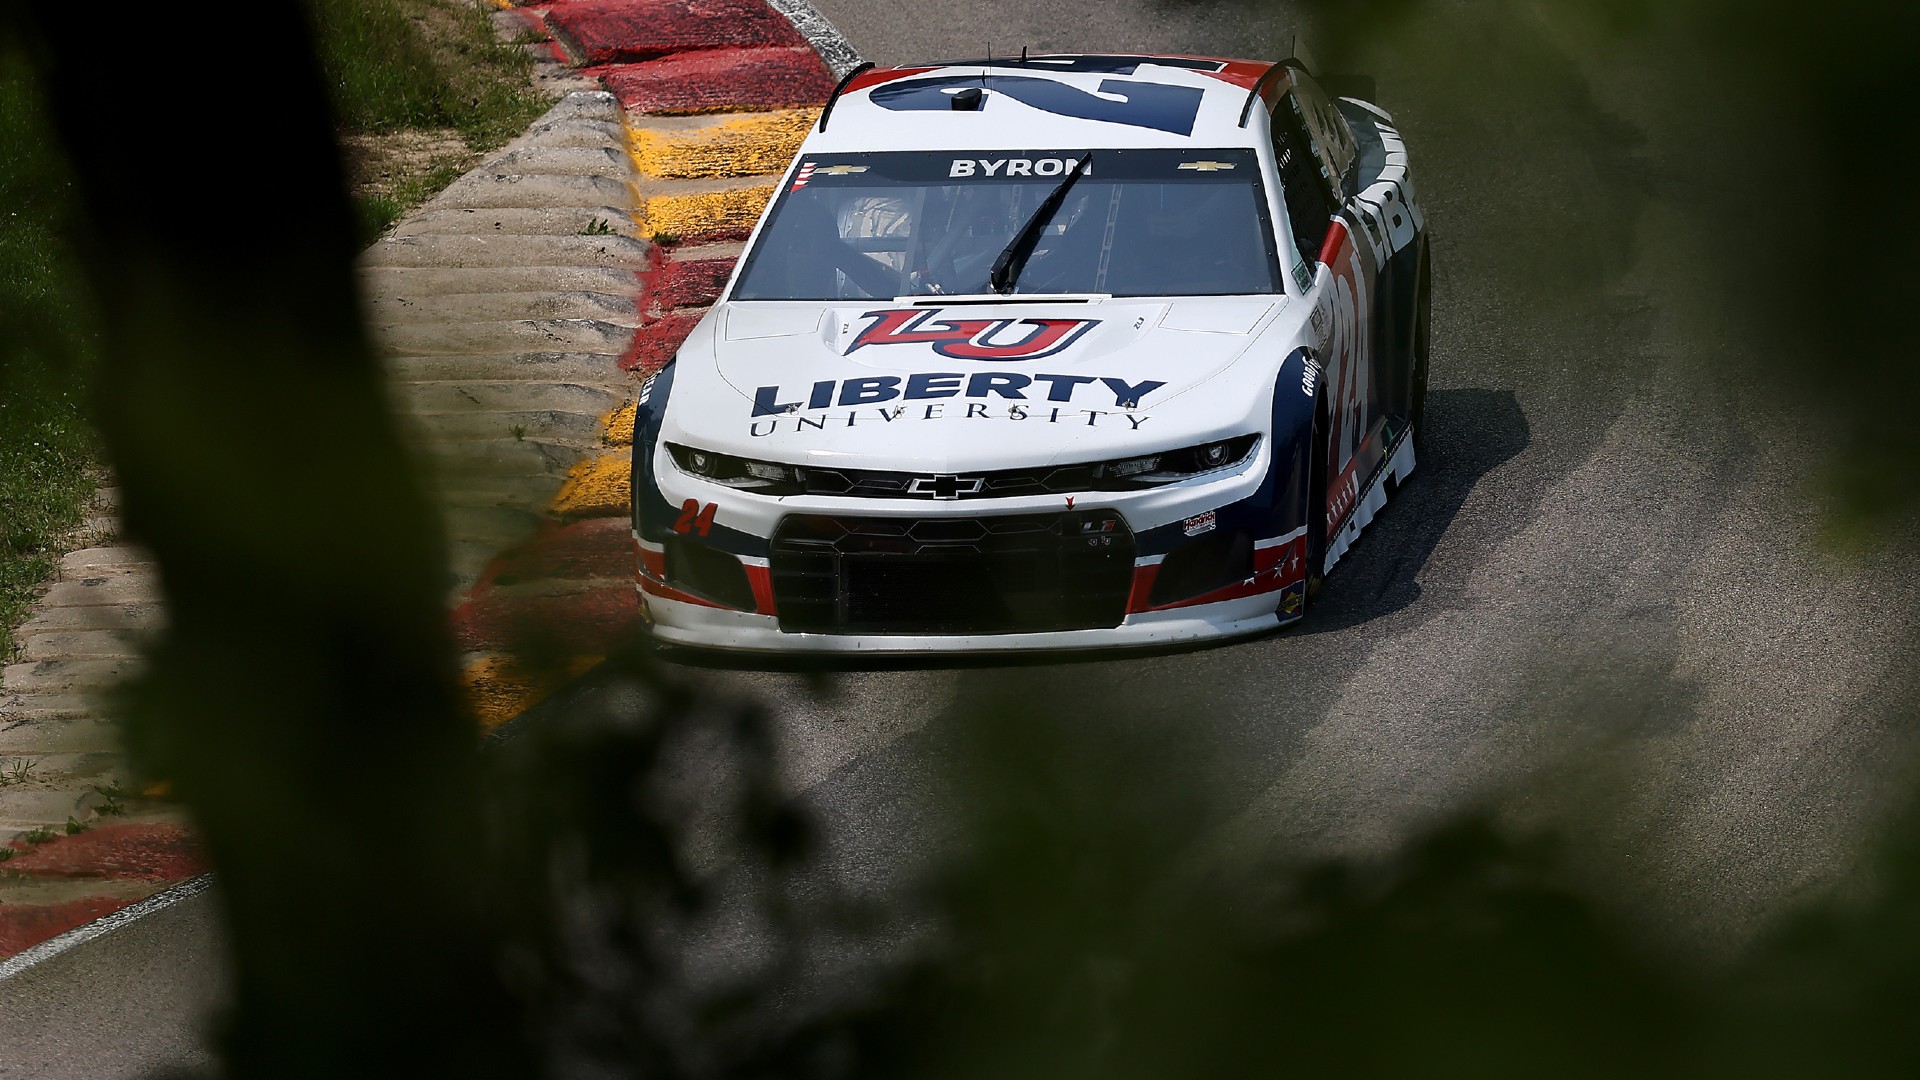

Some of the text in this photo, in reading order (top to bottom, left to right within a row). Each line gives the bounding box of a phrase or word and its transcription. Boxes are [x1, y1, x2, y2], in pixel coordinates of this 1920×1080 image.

[948, 156, 1093, 179] BYRON
[842, 308, 1104, 362] LU
[752, 372, 1169, 418] LIBERTY
[750, 402, 1151, 437] UNIVERSITY
[673, 498, 719, 537] 24
